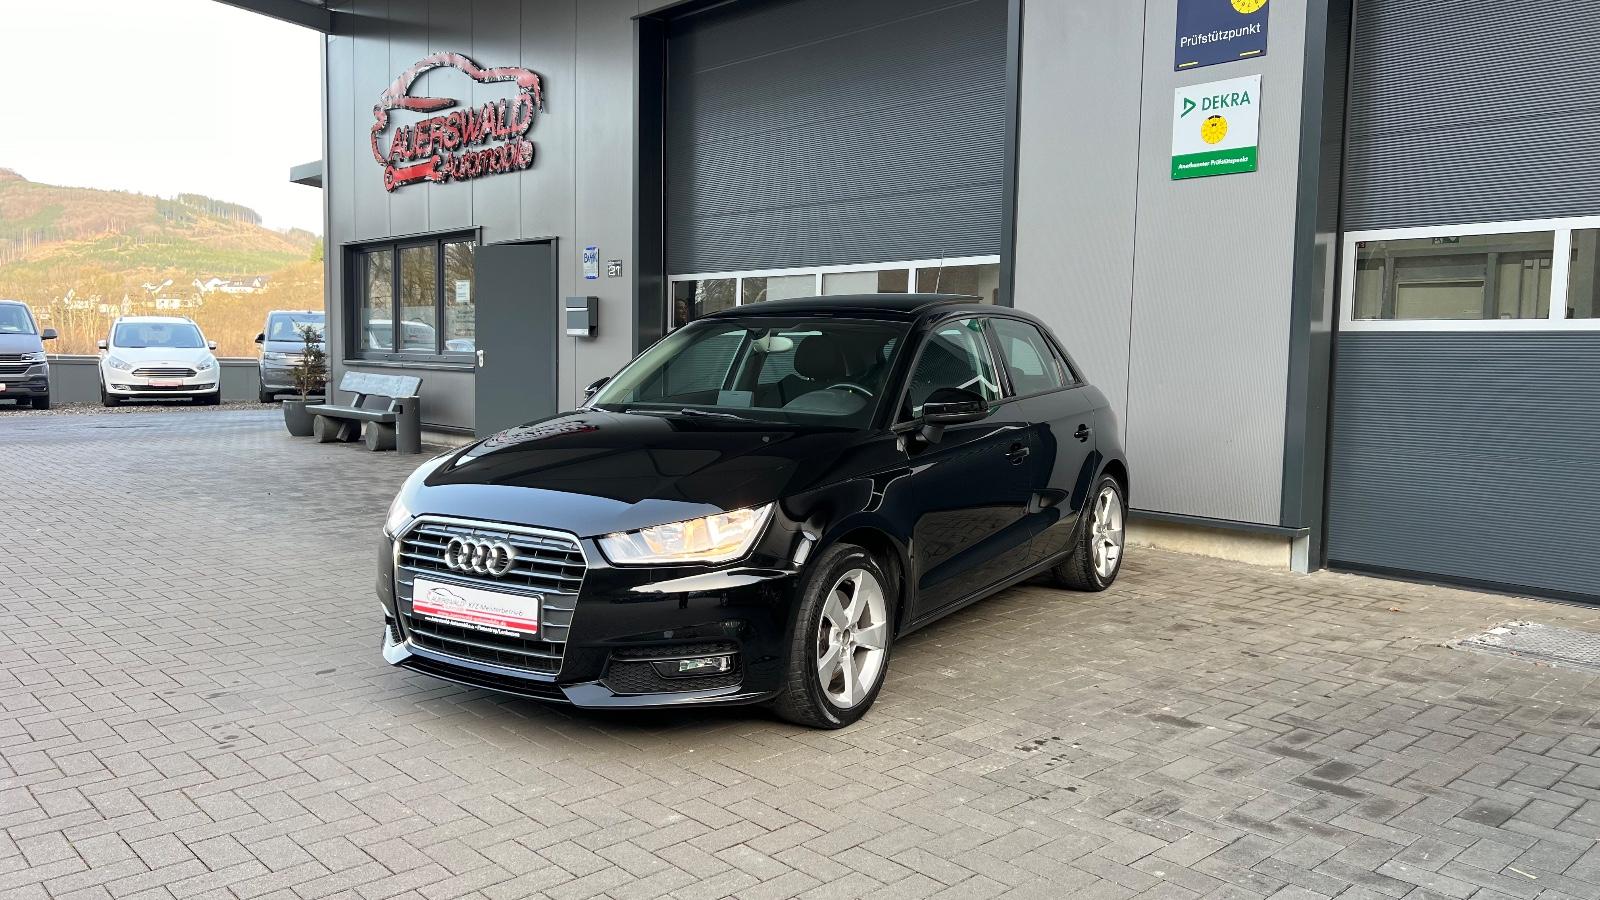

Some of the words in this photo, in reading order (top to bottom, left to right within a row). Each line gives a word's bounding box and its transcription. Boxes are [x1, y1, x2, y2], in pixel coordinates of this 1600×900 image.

[1179, 22, 1262, 48] Prüfstützpunkt
[1202, 90, 1251, 111] DEKRA
[388, 92, 535, 163] AUERSWALD
[608, 265, 621, 276] 21
